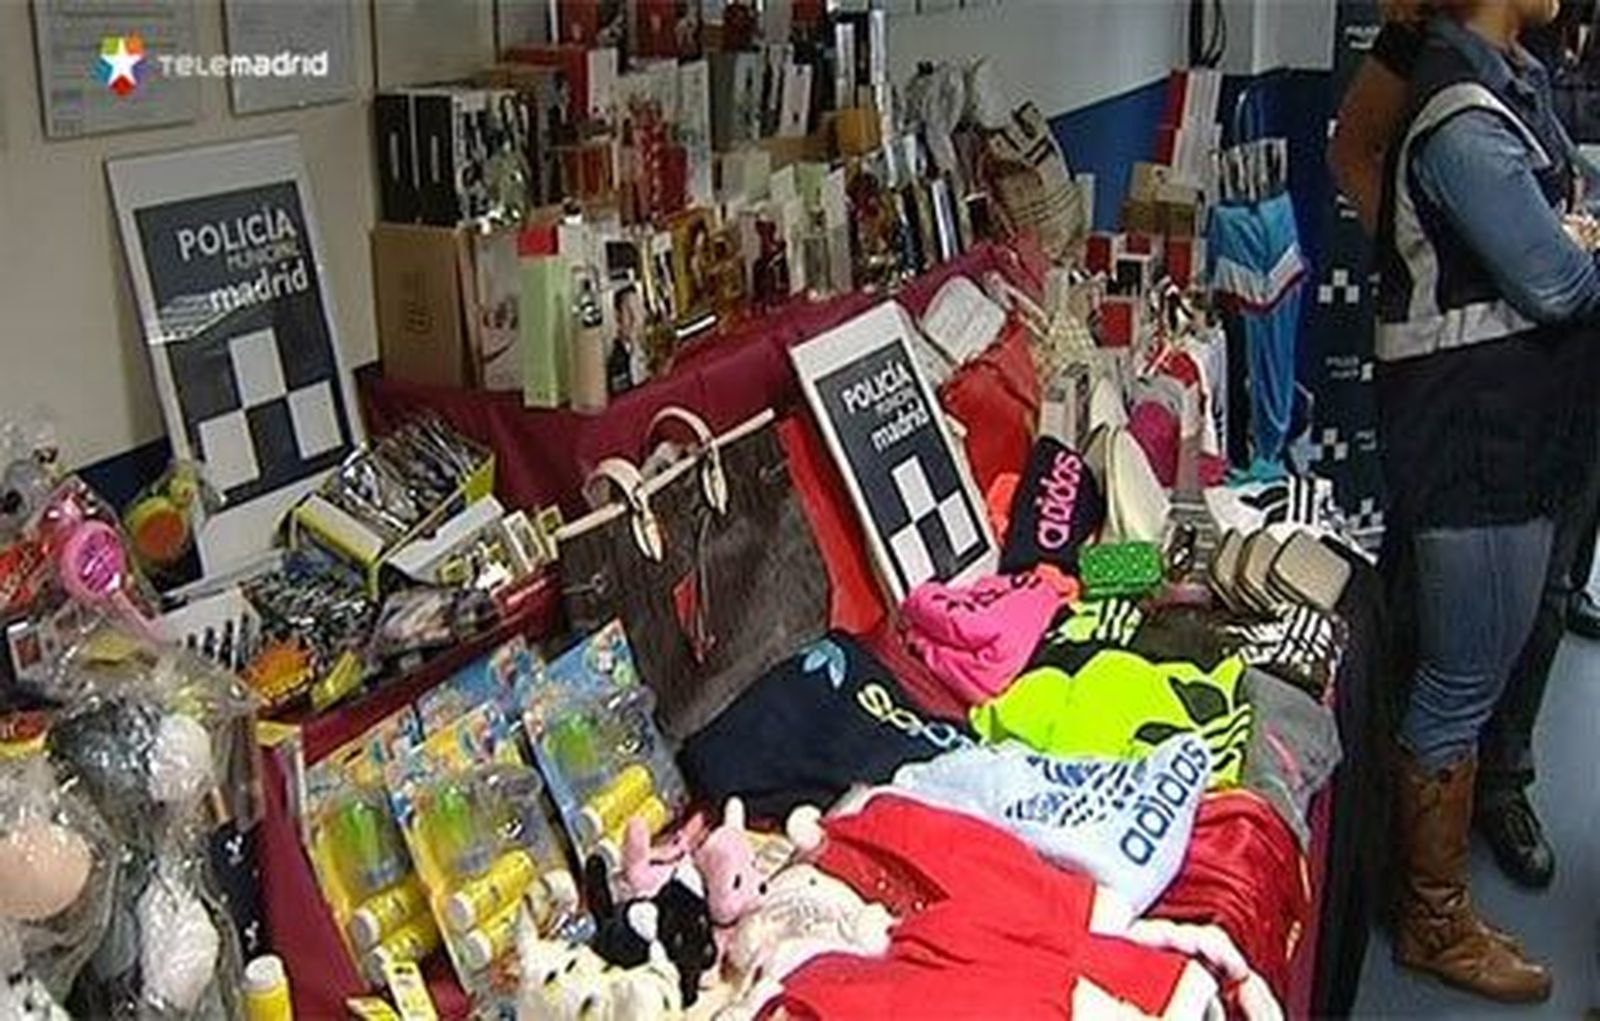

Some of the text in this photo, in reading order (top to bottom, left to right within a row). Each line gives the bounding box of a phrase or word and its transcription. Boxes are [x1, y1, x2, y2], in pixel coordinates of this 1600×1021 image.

[210, 258, 309, 312] madrid
[1037, 451, 1082, 549] adidas
[1119, 739, 1208, 867] adidas
